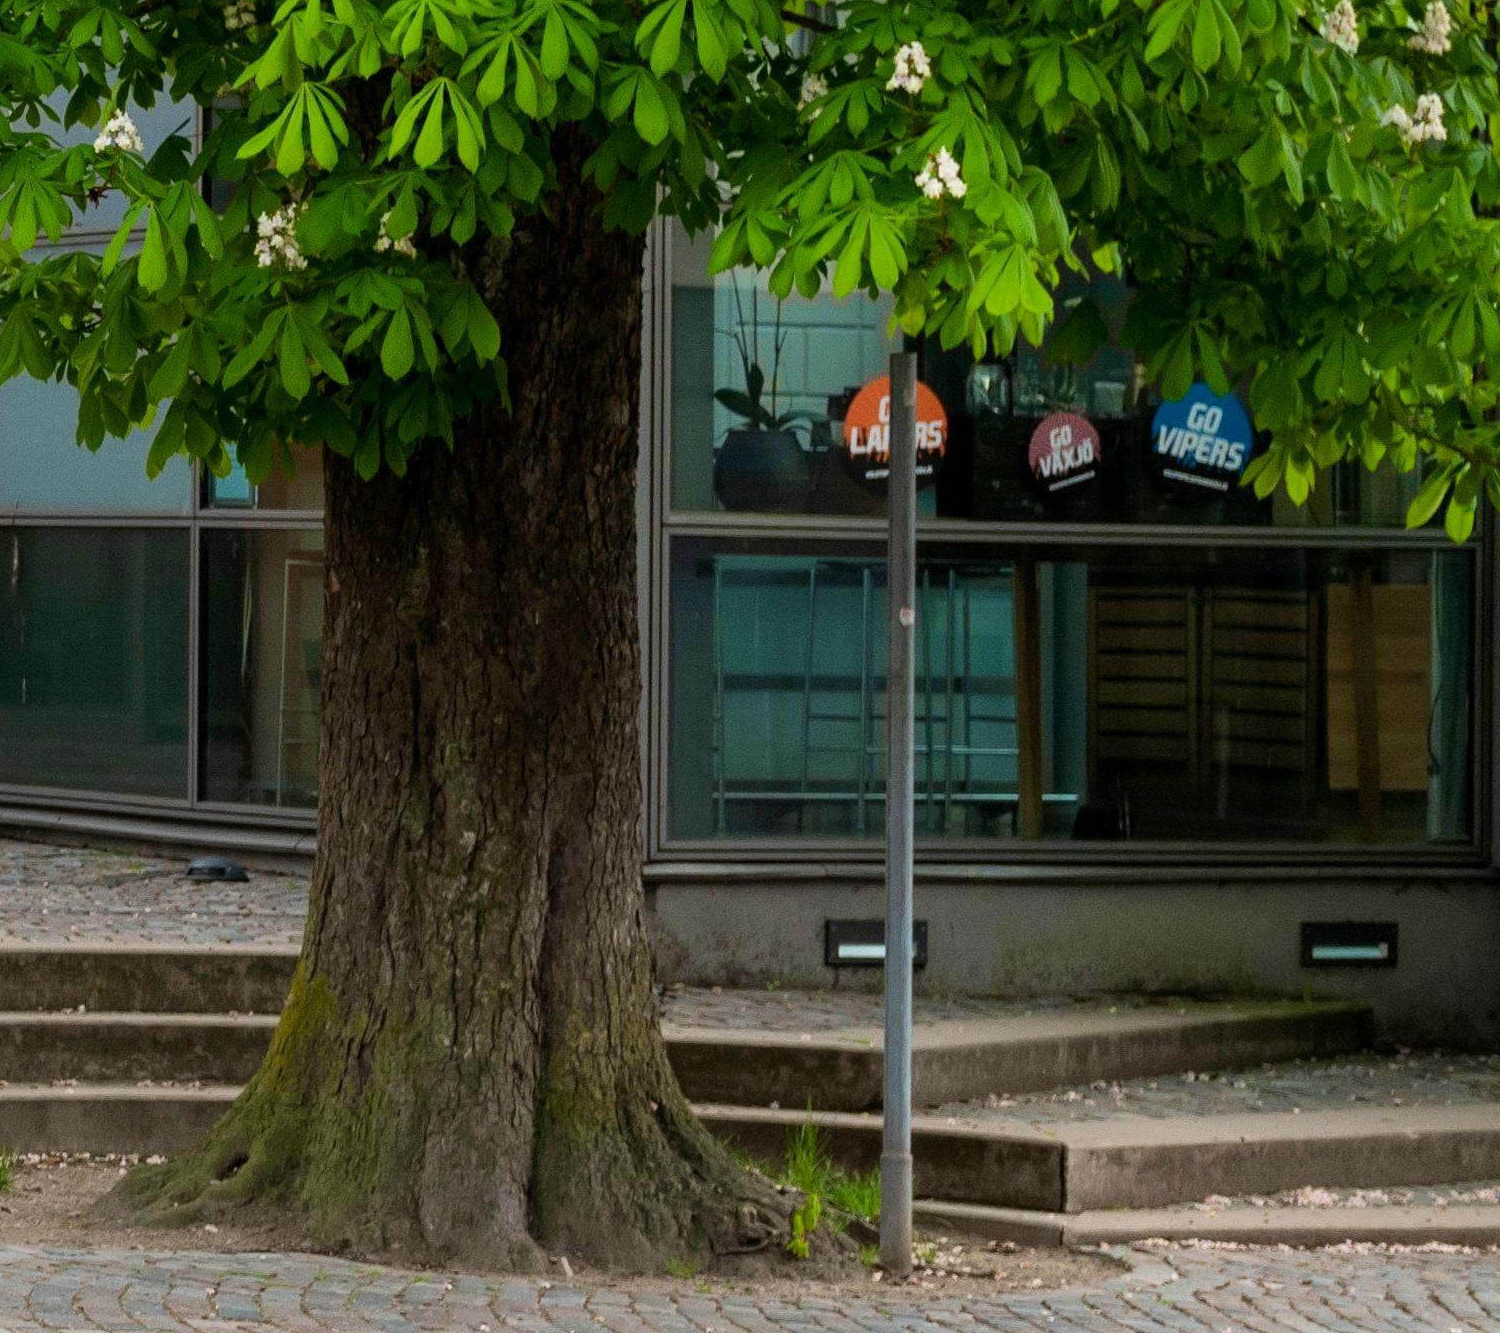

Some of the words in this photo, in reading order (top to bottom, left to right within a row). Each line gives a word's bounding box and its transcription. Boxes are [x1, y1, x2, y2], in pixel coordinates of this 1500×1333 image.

[1186, 402, 1223, 434] GO
[850, 419, 943, 455] LARS
[1049, 424, 1072, 449] GO
[1158, 424, 1245, 471] VIPERS
